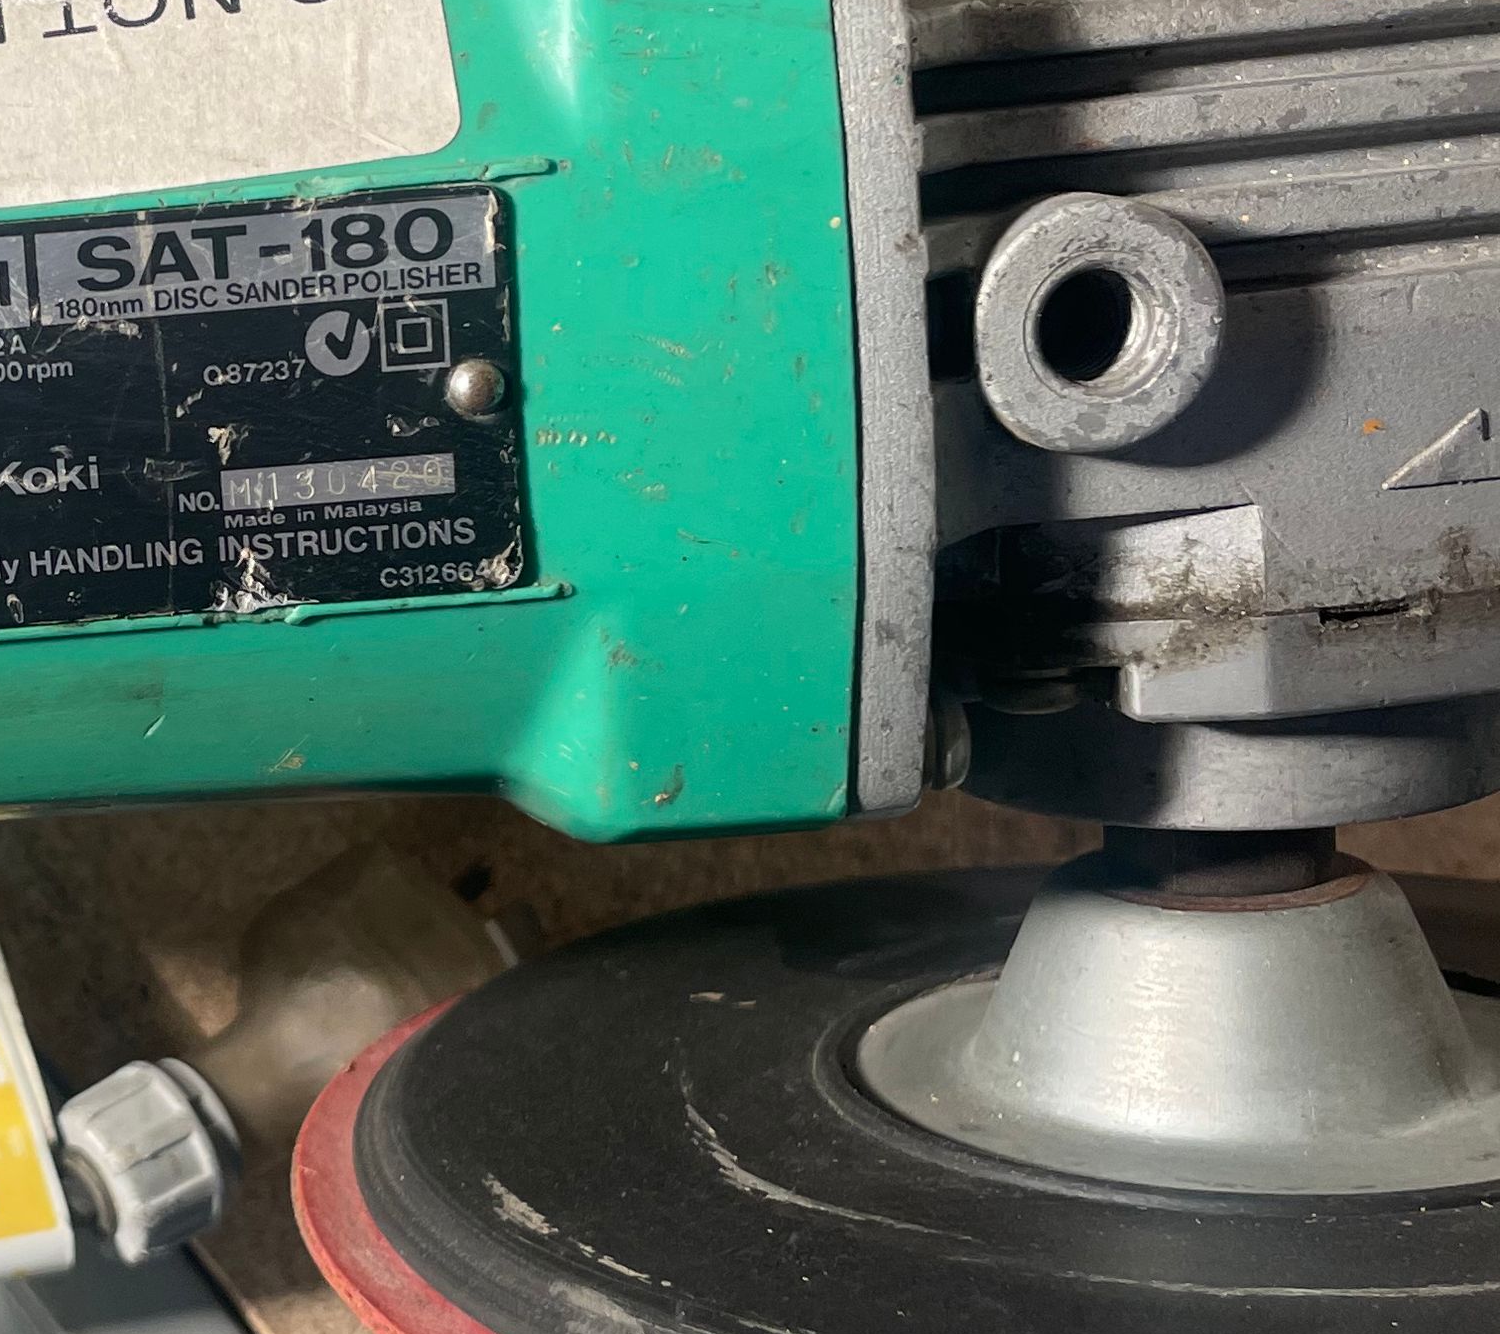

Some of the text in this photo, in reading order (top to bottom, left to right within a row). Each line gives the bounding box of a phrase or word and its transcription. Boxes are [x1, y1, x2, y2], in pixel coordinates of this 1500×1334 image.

[76, 207, 454, 293] SAT-180
[54, 262, 483, 321] 180mm DISC SANDER POLISHER
[177, 490, 221, 514] NO.
[223, 498, 423, 530] Made in Malaysia
[28, 539, 204, 578] HANDLING
[218, 517, 477, 563] INSTRUCTIONS
